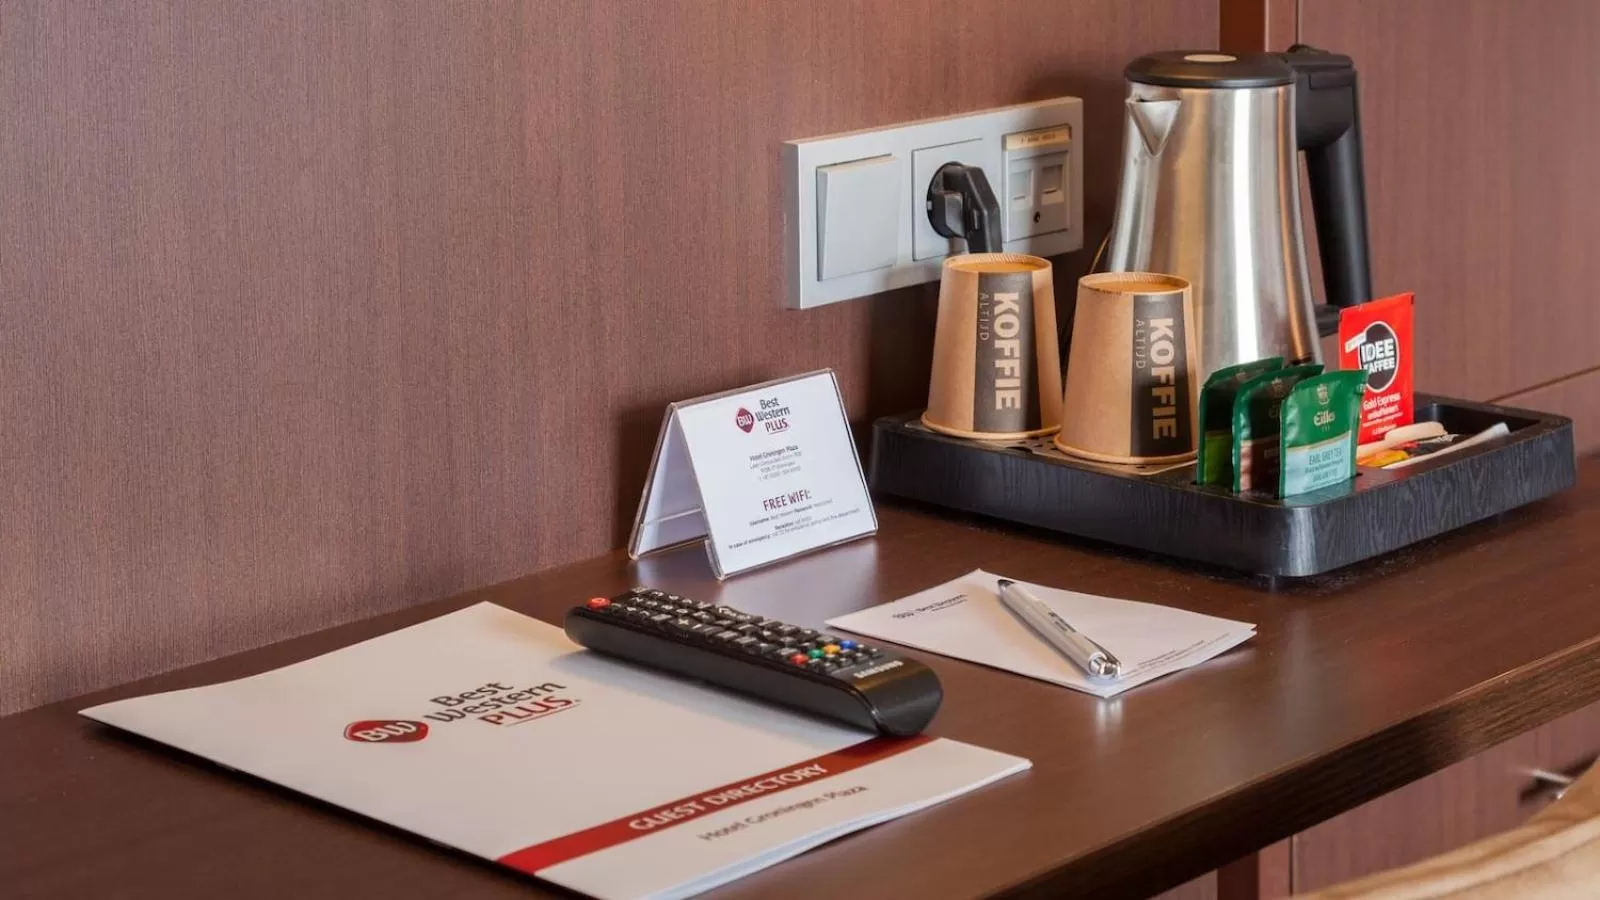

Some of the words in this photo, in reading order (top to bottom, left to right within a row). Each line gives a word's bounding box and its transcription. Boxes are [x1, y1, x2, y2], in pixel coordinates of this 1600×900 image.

[980, 293, 990, 341] ALTIJD
[994, 292, 1021, 410] KOFFIE
[1135, 319, 1147, 369] ALTIJD
[1360, 338, 1395, 363] IDEE
[1149, 318, 1177, 440] KOFFIE
[755, 406, 791, 422] Western
[760, 397, 780, 409] Best
[765, 417, 788, 432] PLUS
[763, 495, 787, 511] FREE
[423, 682, 567, 722] Western
[429, 681, 515, 706] Best
[478, 695, 574, 725] PLUS
[353, 721, 417, 742] BW
[628, 801, 706, 831] GUEST
[703, 763, 829, 806] DIRECTORY
